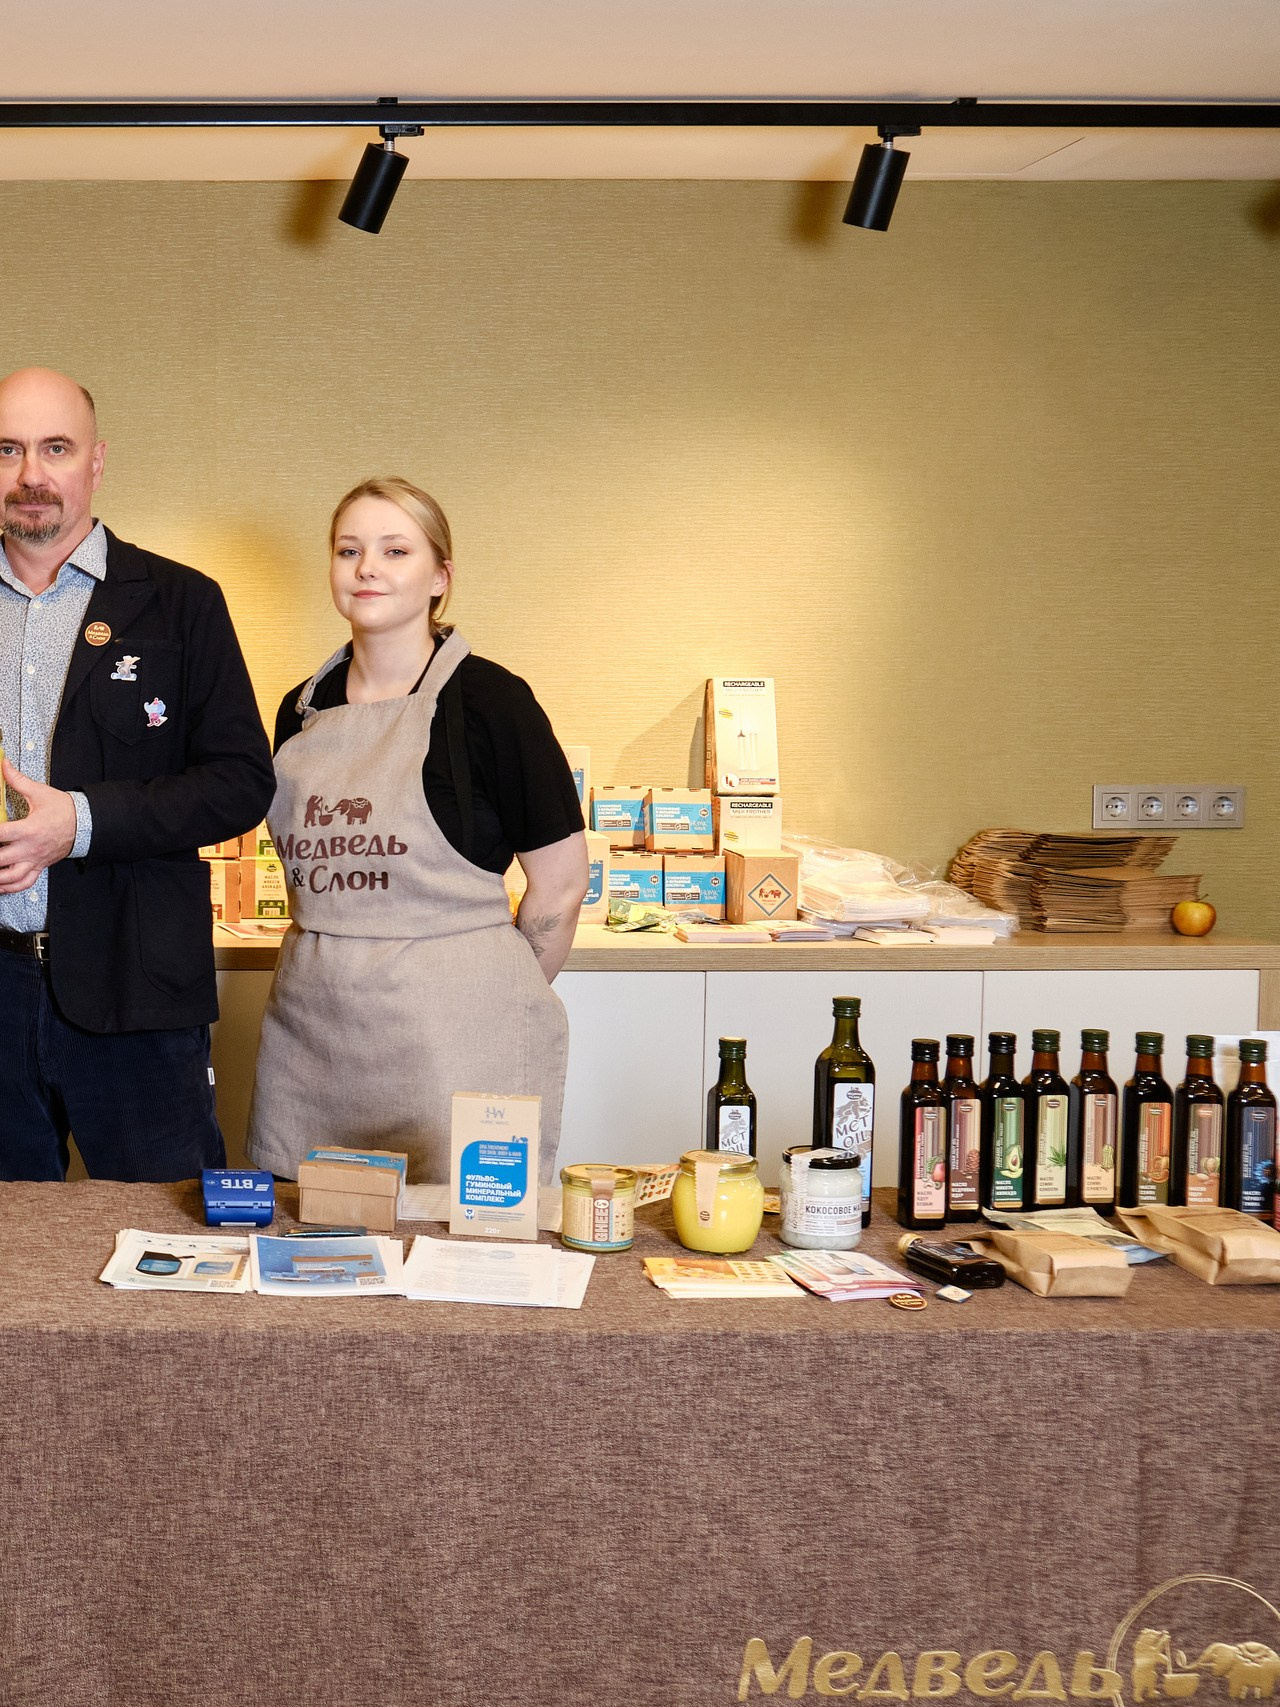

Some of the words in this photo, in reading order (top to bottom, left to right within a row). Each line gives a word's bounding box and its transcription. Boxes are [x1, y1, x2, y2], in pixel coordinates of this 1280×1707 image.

[276, 833, 408, 861] Медведь
[293, 867, 305, 888] &
[310, 865, 389, 894] Слон
[836, 1115, 869, 1139] MCT
[721, 1131, 746, 1149] MCT
[843, 1131, 870, 1148] OIL
[221, 1179, 253, 1189] ВТБ
[465, 1174, 500, 1182] ФУЛЬВО-
[465, 1180, 512, 1190] ГУМИНОВЫЙ
[465, 1187, 522, 1197] МИНЕРАЛЬНЫЙ
[465, 1194, 505, 1203] КОМПЛЕКС
[805, 1205, 851, 1215] КОКОСОВОЕ
[594, 1208, 609, 1242] GHEE
[738, 1636, 1125, 1702] Медведь
